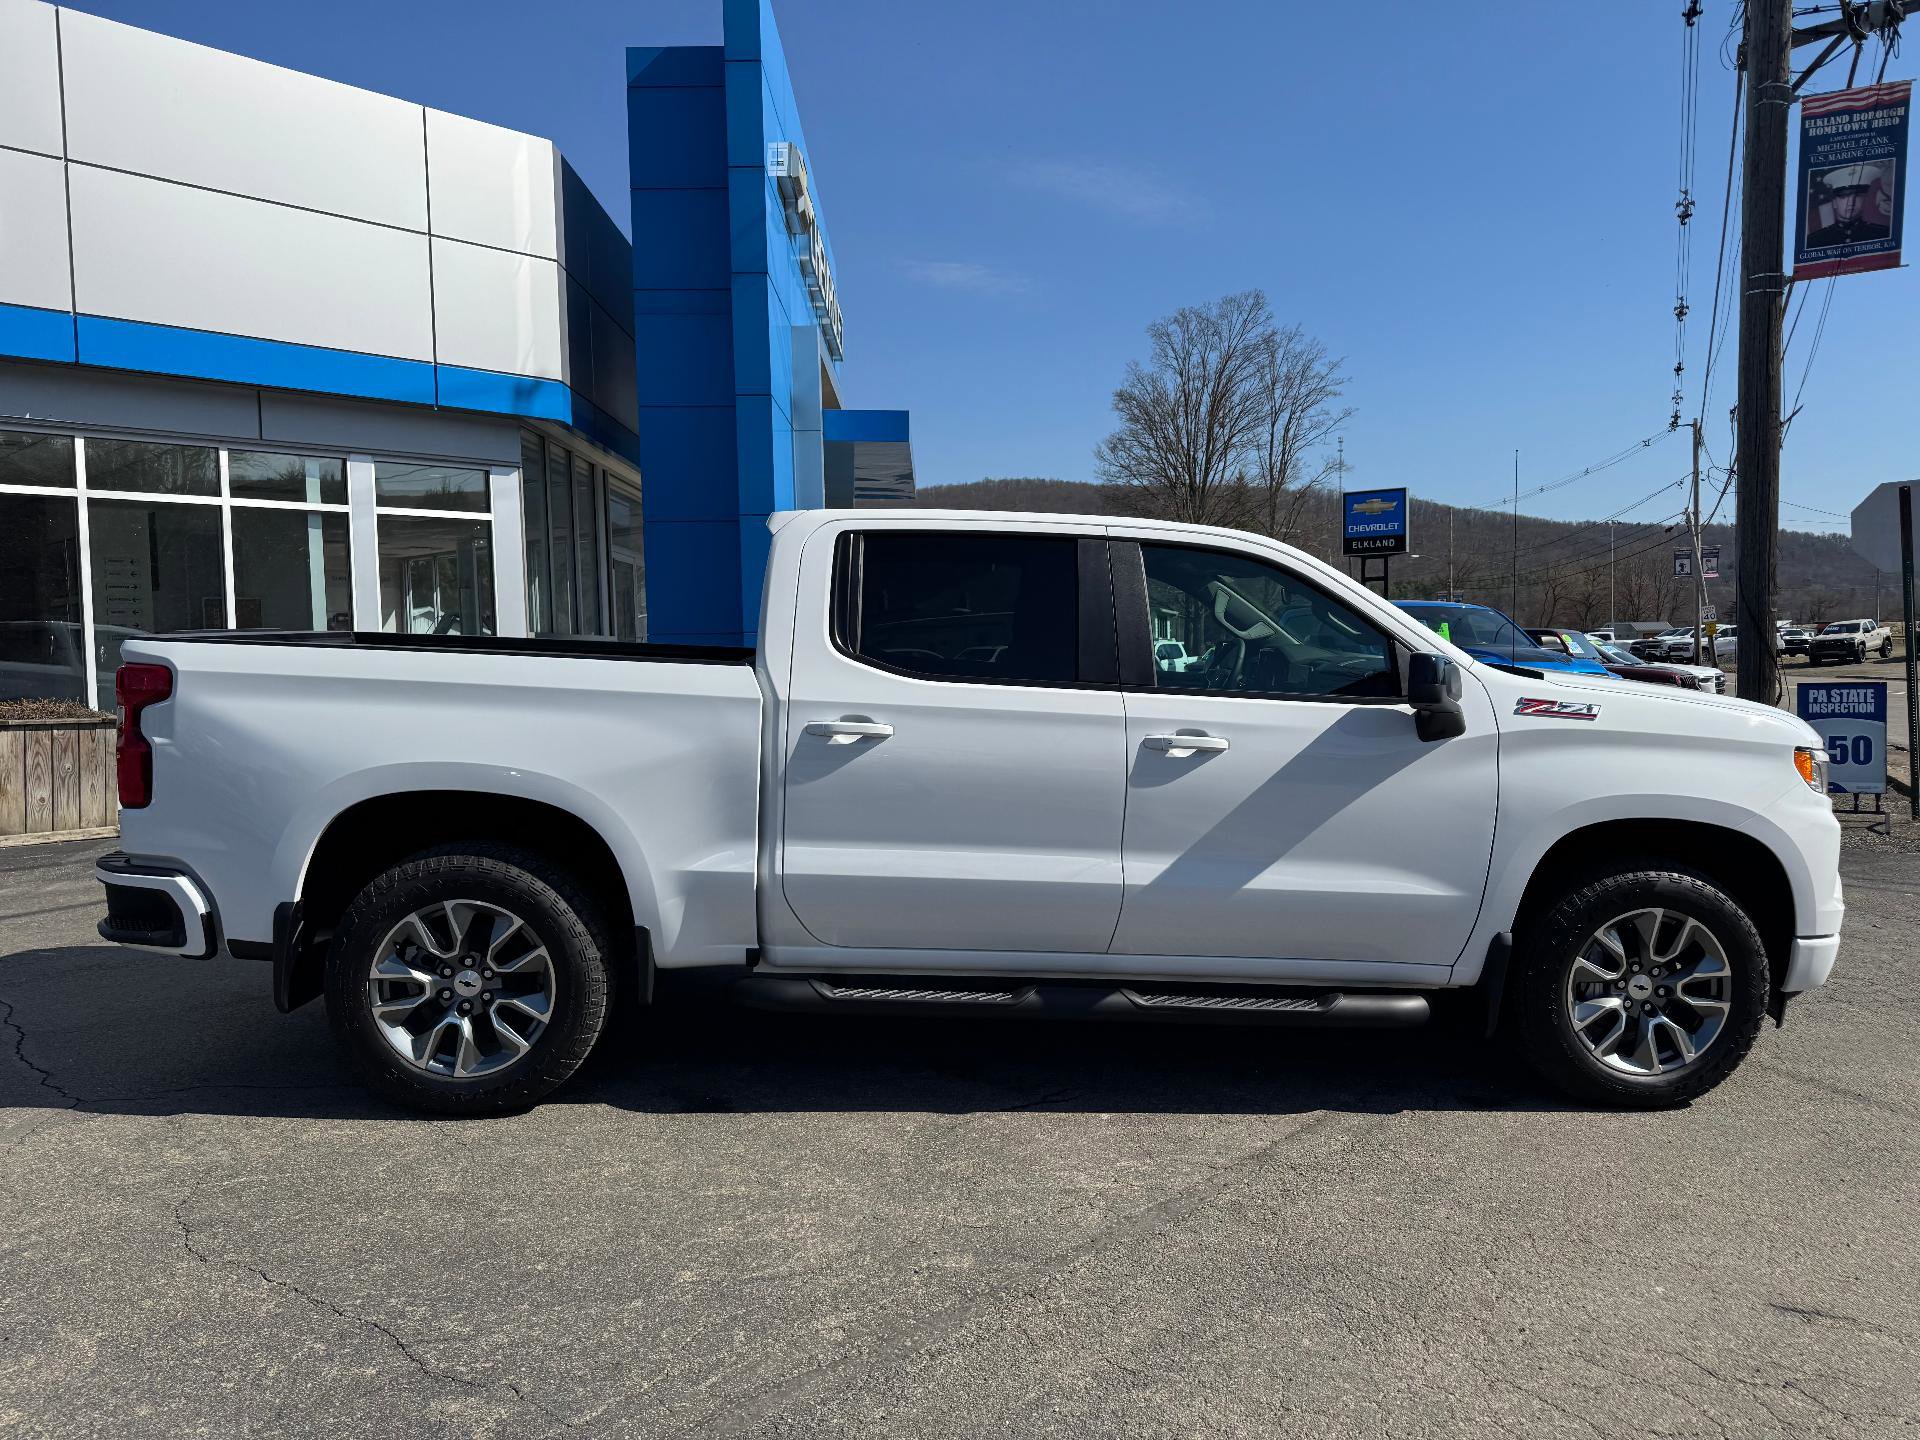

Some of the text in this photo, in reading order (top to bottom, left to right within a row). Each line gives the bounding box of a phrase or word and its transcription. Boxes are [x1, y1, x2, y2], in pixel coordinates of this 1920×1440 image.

[1805, 107, 1905, 128] ELKLAND BOROUGH
[1808, 117, 1900, 136] HOMETOWN HERO
[1817, 136, 1889, 152] MICHAEL PLANK
[1810, 146, 1895, 163] U.S. MARINE CORPS
[1799, 251, 1826, 259] GLOBAL
[1348, 522, 1399, 533] CHEVROLET
[1352, 539, 1395, 549] ELKLAND
[1808, 688, 1875, 703] PA STATE
[1513, 697, 1601, 721] Z71
[1808, 702, 1875, 714] INSPECTION
[1828, 735, 1872, 765] 50
